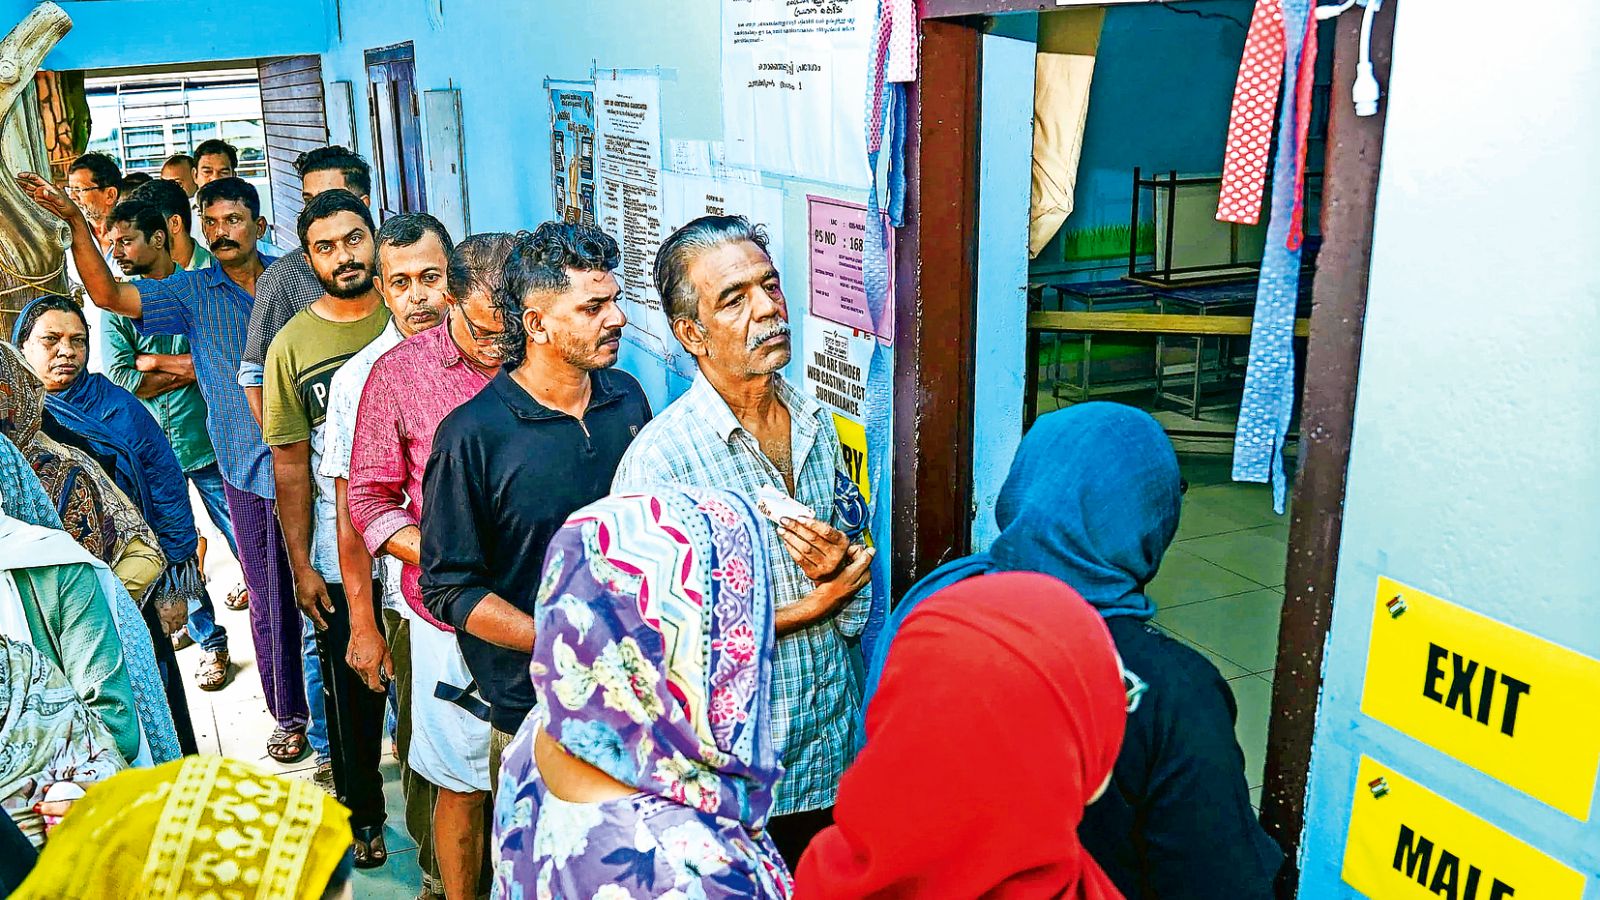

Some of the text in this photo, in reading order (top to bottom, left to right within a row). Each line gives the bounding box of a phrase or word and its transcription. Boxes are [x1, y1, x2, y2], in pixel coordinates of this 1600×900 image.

[705, 205, 724, 216] NOTICE
[815, 229, 823, 243] PS
[824, 231, 836, 246] NO
[849, 236, 864, 252] 168
[813, 351, 861, 382] YOU ARE UNDER
[807, 365, 821, 382] WEB
[821, 371, 846, 394] CASTING
[851, 383, 866, 402] CCT
[815, 385, 861, 417] SURVEILLANCE.
[840, 441, 863, 484] RY
[1422, 641, 1531, 738] EXIT
